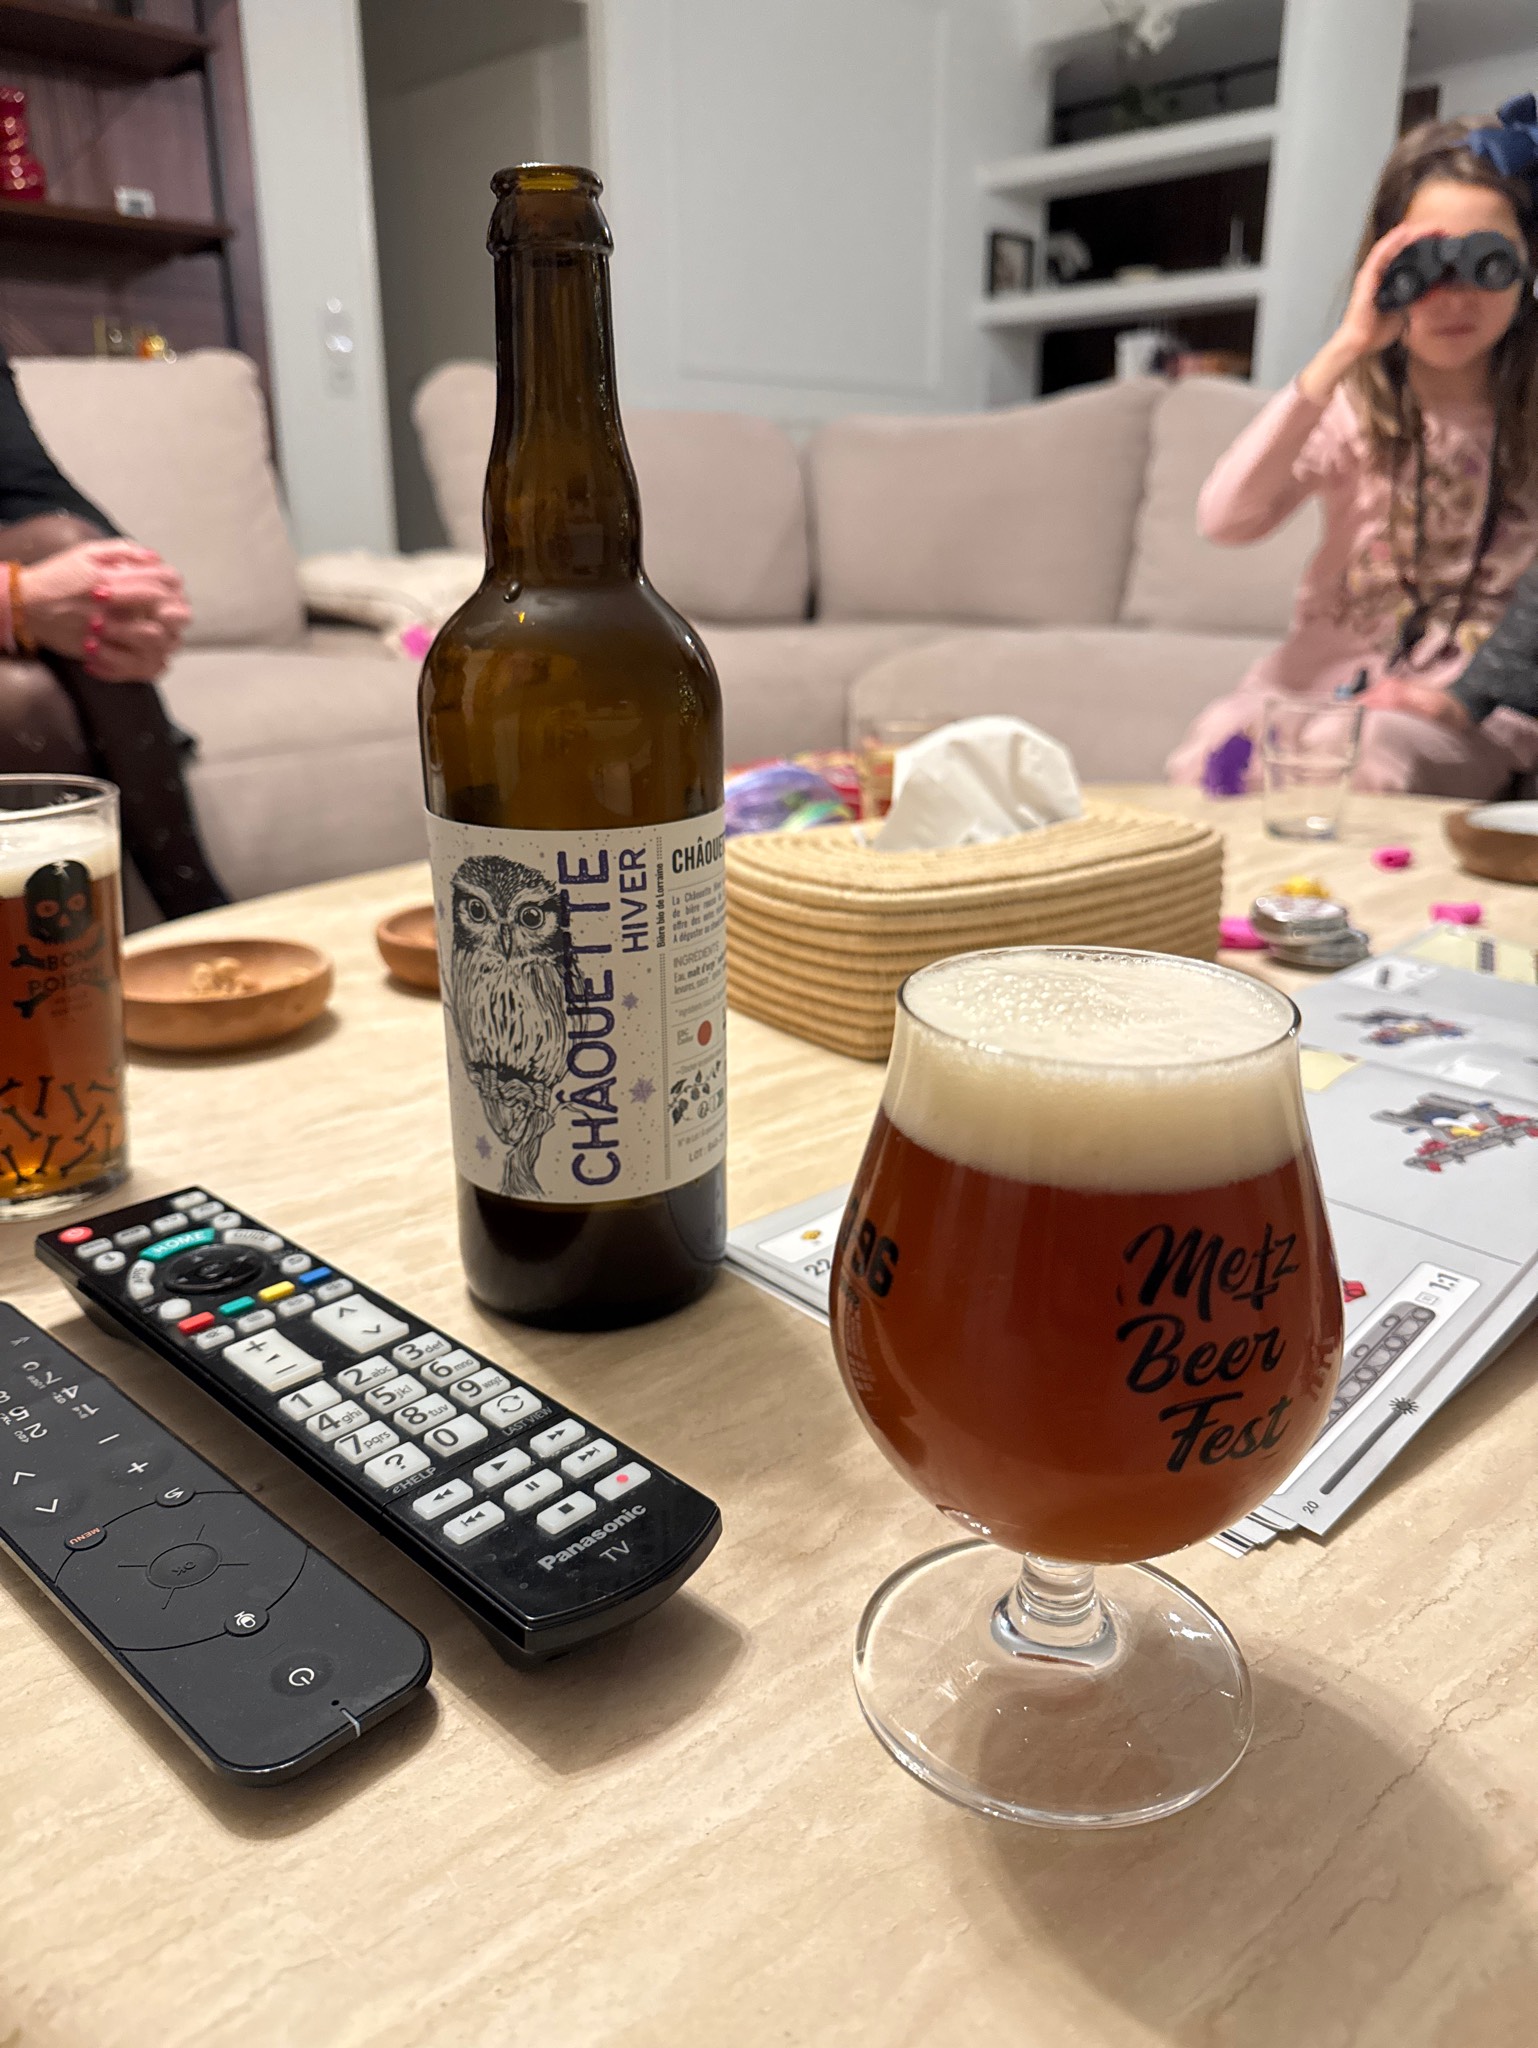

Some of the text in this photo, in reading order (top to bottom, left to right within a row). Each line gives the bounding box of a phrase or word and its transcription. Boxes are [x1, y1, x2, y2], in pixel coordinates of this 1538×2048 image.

[619, 848, 650, 954] HIVER
[655, 863, 666, 948] Bière bio de Lorraine
[556, 849, 621, 1186] CHÂOUETTE
[153, 1231, 206, 1254] HOME
[132, 1267, 147, 1283] APPS
[1123, 1221, 1299, 1322] Metz
[1116, 1312, 1286, 1395] Beer
[61, 1385, 79, 1399] 4
[290, 1393, 313, 1409] 1
[8, 1406, 30, 1421] 5
[502, 1407, 553, 1436] LAST VIEW
[23, 1423, 48, 1438] 2
[1159, 1391, 1293, 1473] Fest
[1302, 1500, 1319, 1515] 20
[69, 1527, 101, 1545] MENU
[537, 1504, 647, 1571] Panasonic
[600, 1540, 631, 1563] TV
